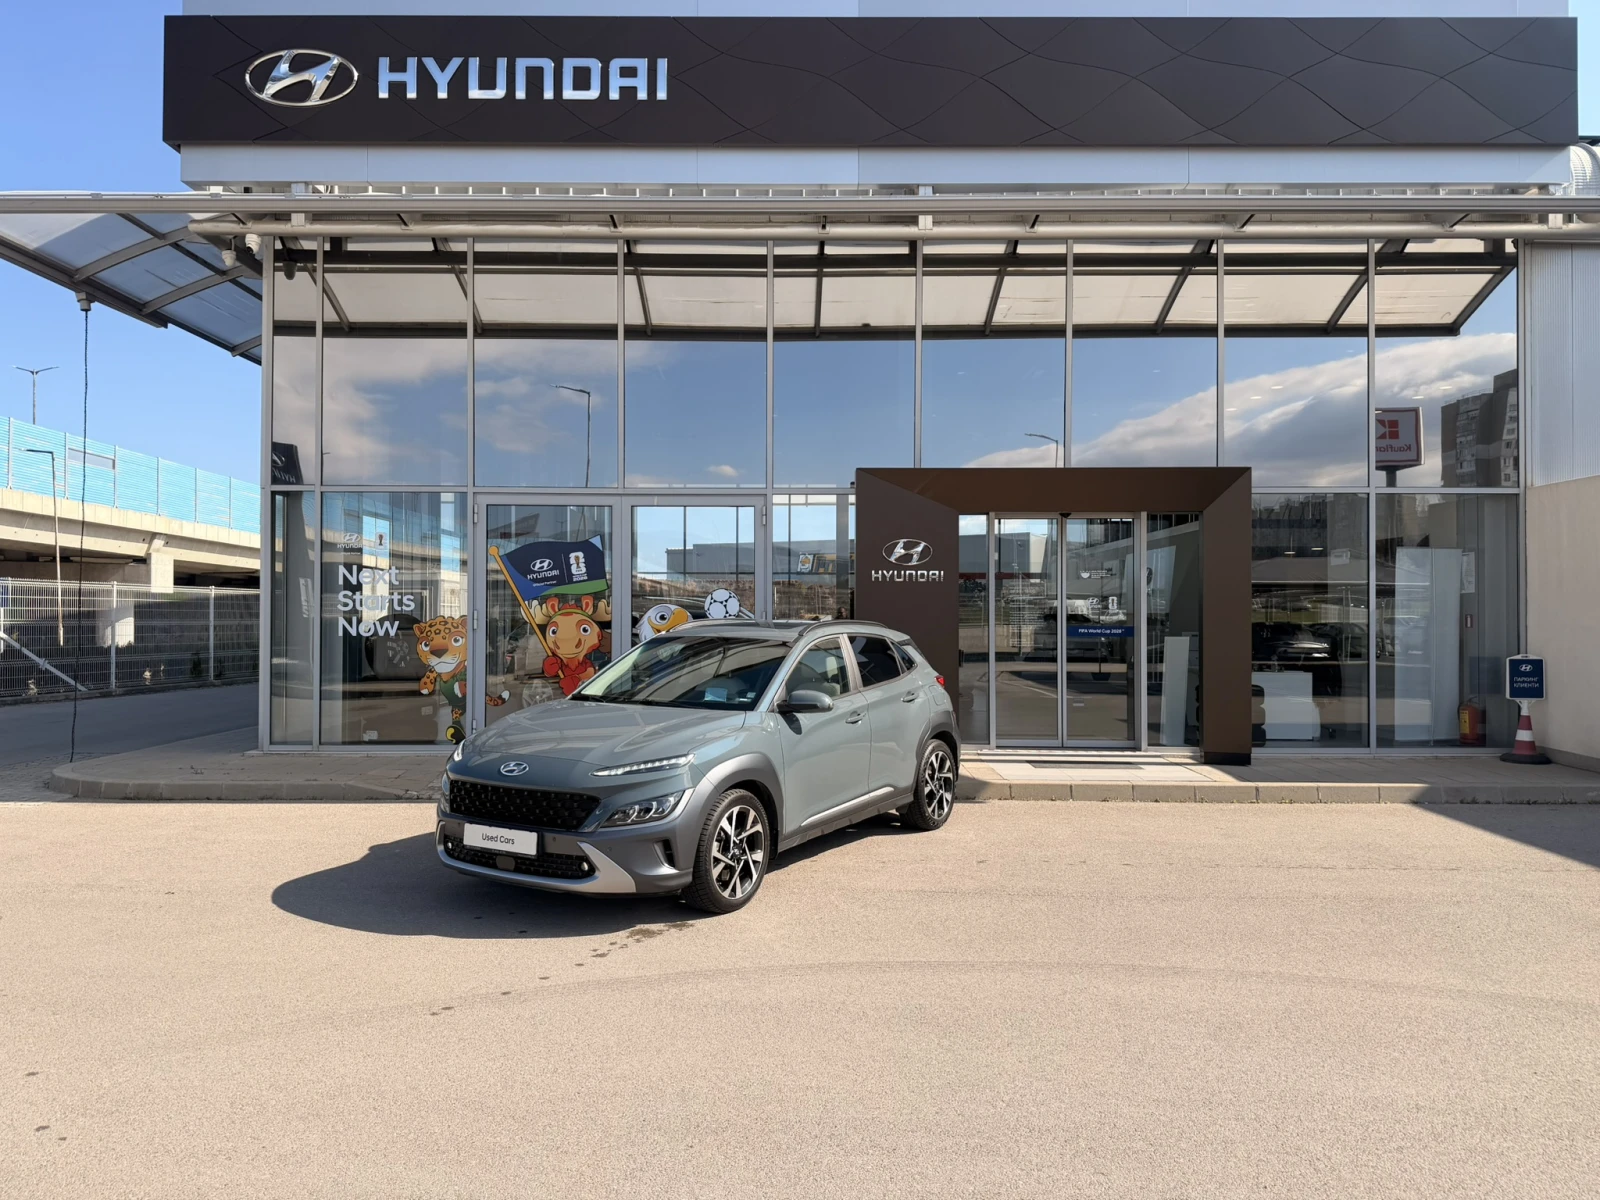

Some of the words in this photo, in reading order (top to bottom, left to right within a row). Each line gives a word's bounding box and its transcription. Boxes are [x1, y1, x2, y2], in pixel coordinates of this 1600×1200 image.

[378, 57, 668, 100] HYUNDAI
[338, 565, 399, 585] Next
[527, 570, 560, 580] HYUNDAI
[871, 570, 944, 582] HYUNDAI
[337, 590, 416, 611] Starts
[338, 616, 400, 637] Now
[481, 832, 499, 843] Used
[499, 835, 515, 845] Cars
